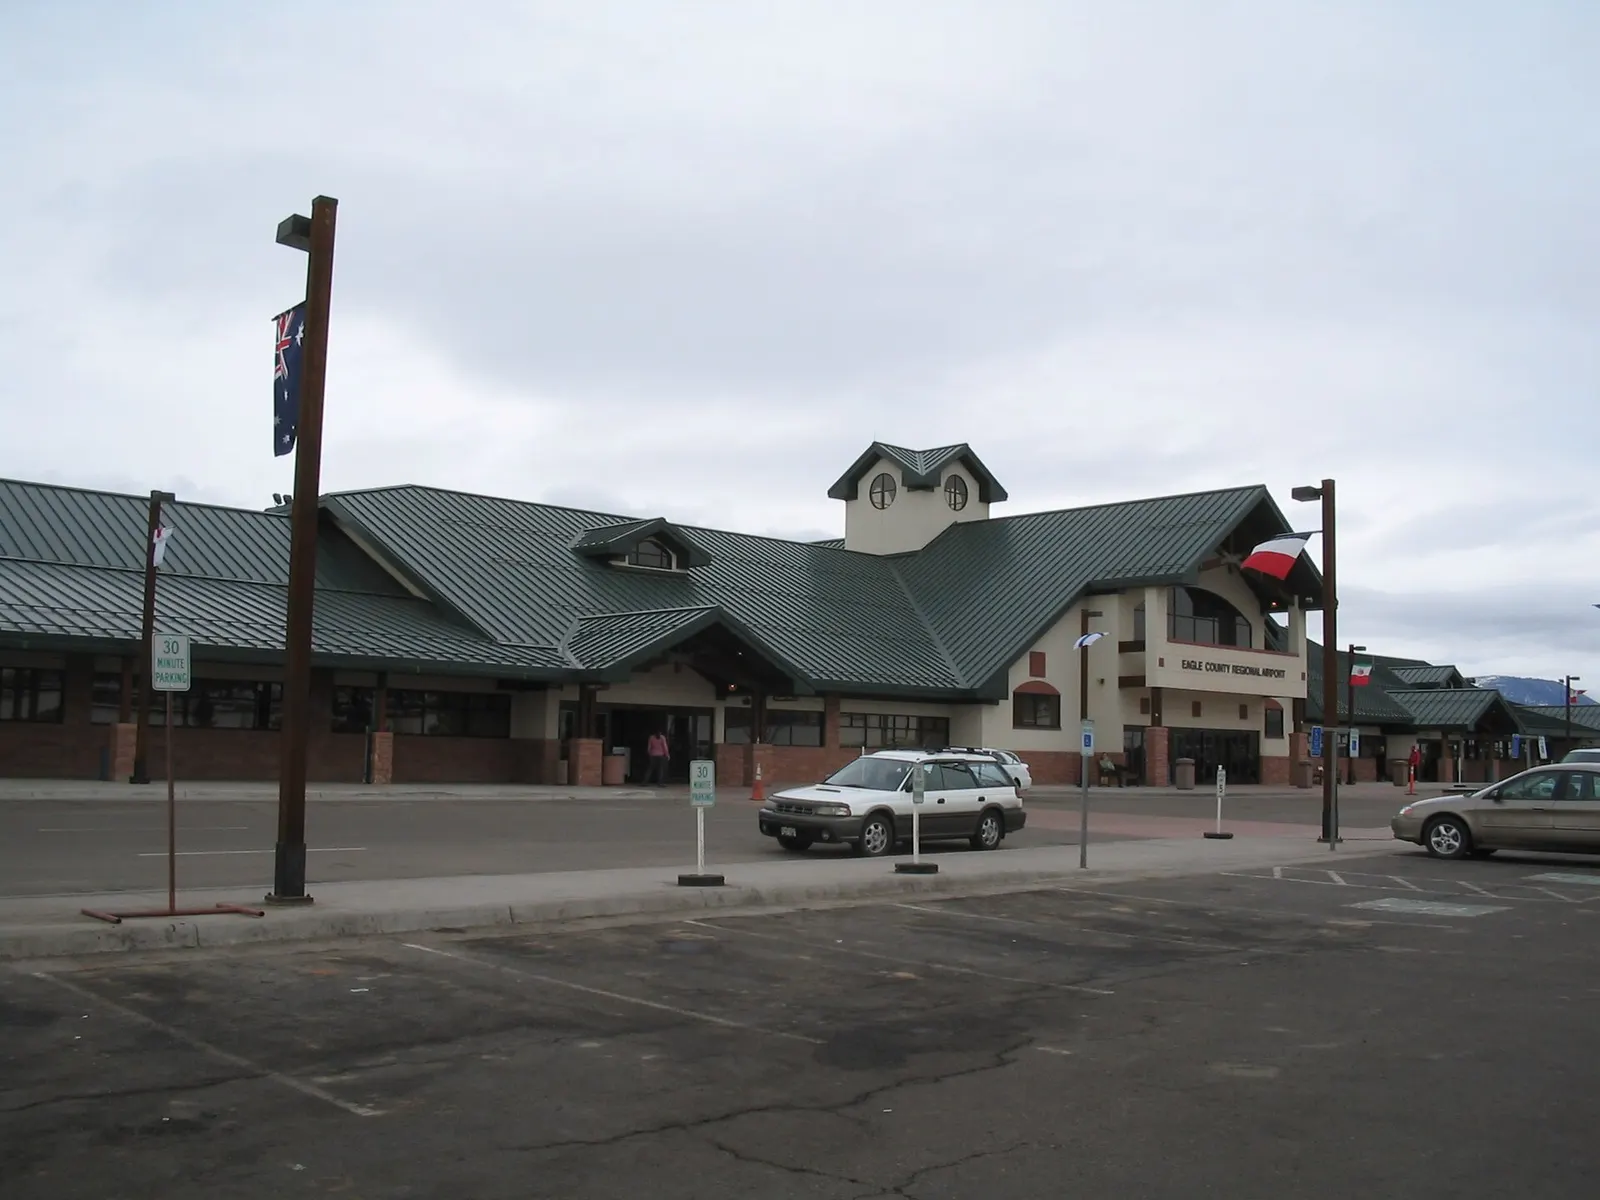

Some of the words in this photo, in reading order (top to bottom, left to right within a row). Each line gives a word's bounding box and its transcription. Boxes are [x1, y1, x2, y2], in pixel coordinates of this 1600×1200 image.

[163, 640, 180, 655] 30
[157, 658, 185, 669] MINUTE
[1181, 660, 1203, 671] EAGLE
[1205, 662, 1231, 673] COUNTY
[1232, 665, 1261, 676] REGIONAL
[1261, 668, 1286, 678] AIRPORT
[155, 672, 186, 683] PARKING
[697, 766, 708, 778] 30
